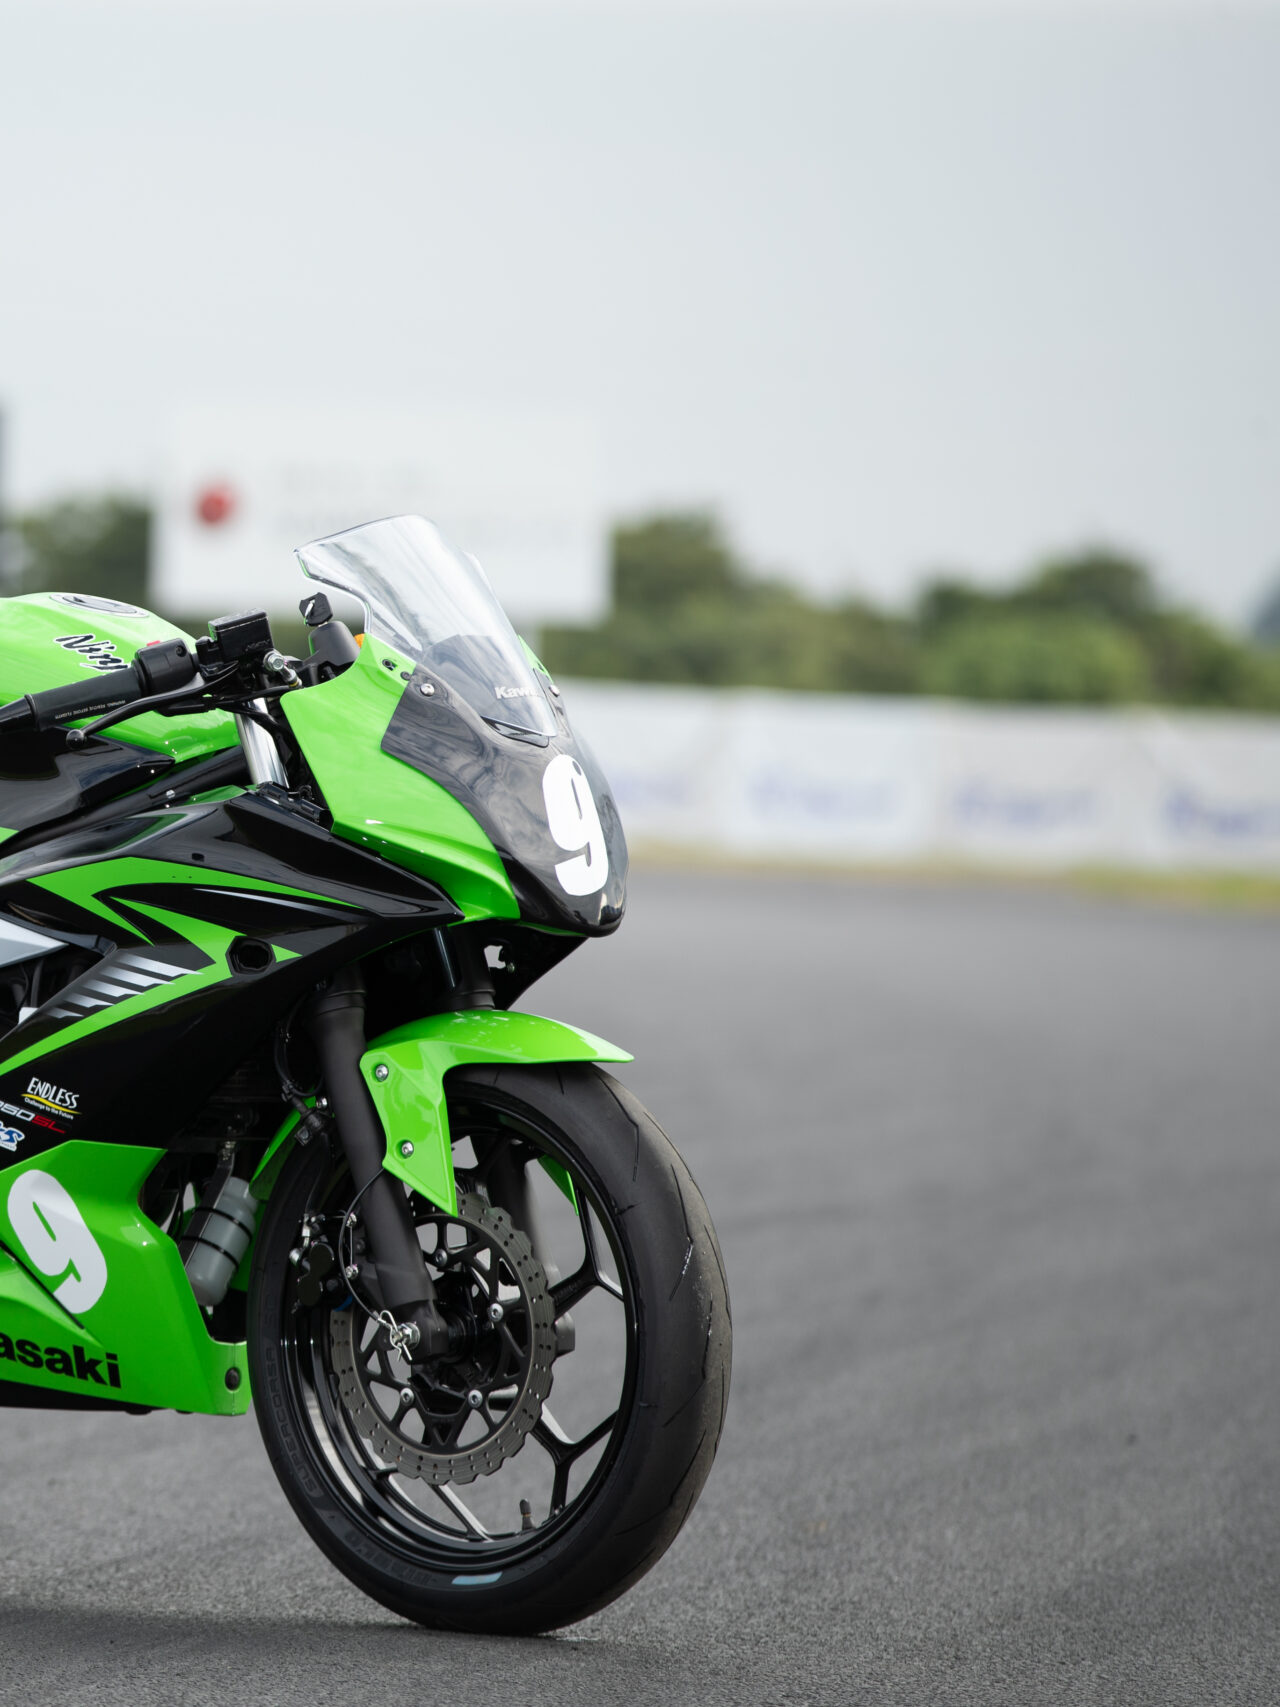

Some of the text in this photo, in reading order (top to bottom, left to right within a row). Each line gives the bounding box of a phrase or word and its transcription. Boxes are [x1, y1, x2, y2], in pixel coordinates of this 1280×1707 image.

[55, 634, 130, 673] Ninj
[542, 754, 609, 896] 9
[26, 1076, 80, 1109] ENDLESS
[7, 1169, 108, 1314] 9
